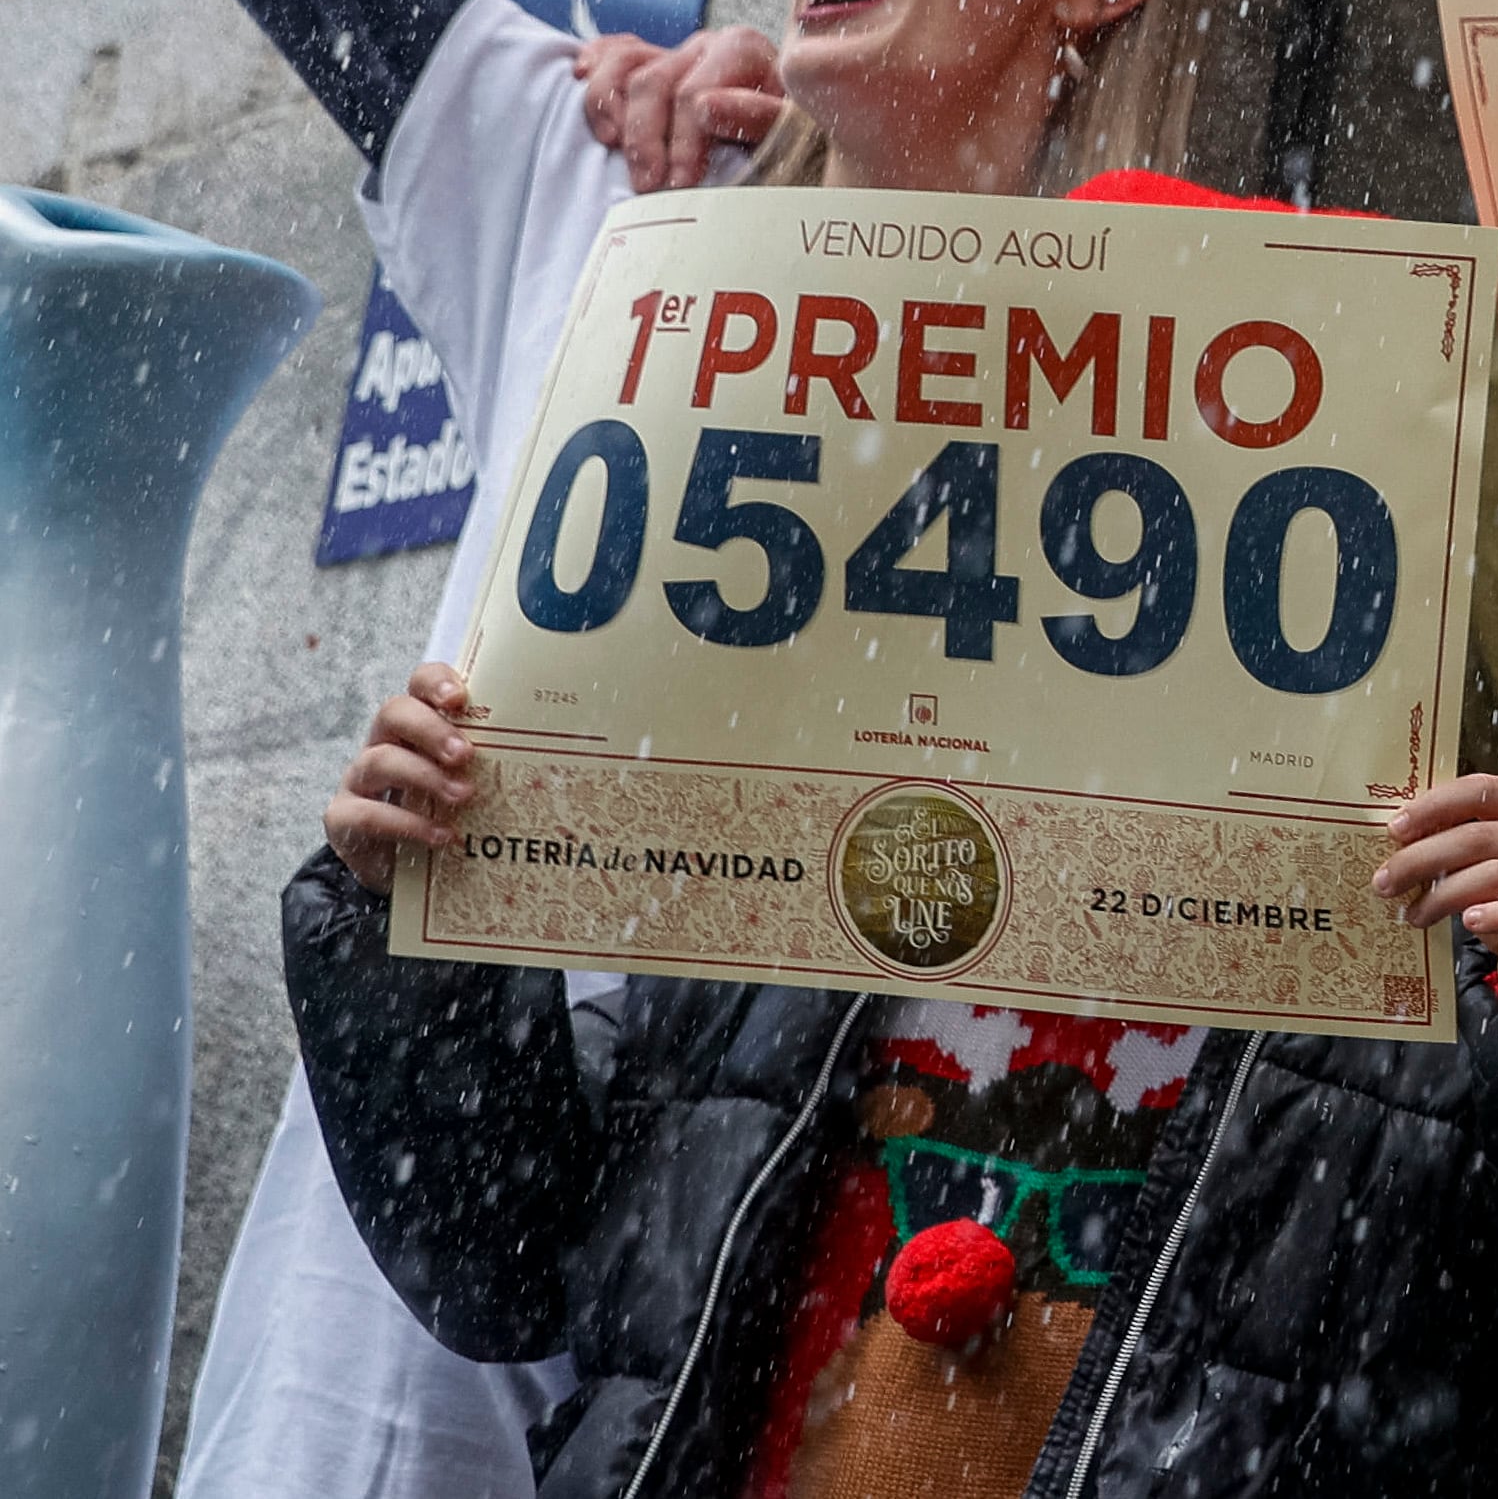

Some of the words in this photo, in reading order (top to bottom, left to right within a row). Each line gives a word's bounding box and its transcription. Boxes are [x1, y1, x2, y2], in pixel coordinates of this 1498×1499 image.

[800, 218, 983, 265] VENDIDO
[994, 226, 1112, 272] AQUÍ
[690, 290, 1324, 450] PREMIO
[516, 418, 1398, 695] 05490
[854, 728, 914, 747] LOTERÍA
[917, 734, 991, 753] NACIONAL
[1249, 750, 1315, 769] MADRID
[464, 832, 598, 870] LOTERÍA
[603, 841, 637, 873] de
[643, 847, 805, 883] NAVIDAD
[865, 837, 977, 884] SORTEO
[893, 876, 935, 901] QUE
[1090, 887, 1127, 915] 22
[1141, 893, 1334, 933] DICIEMBRE
[883, 894, 953, 949] UNE
